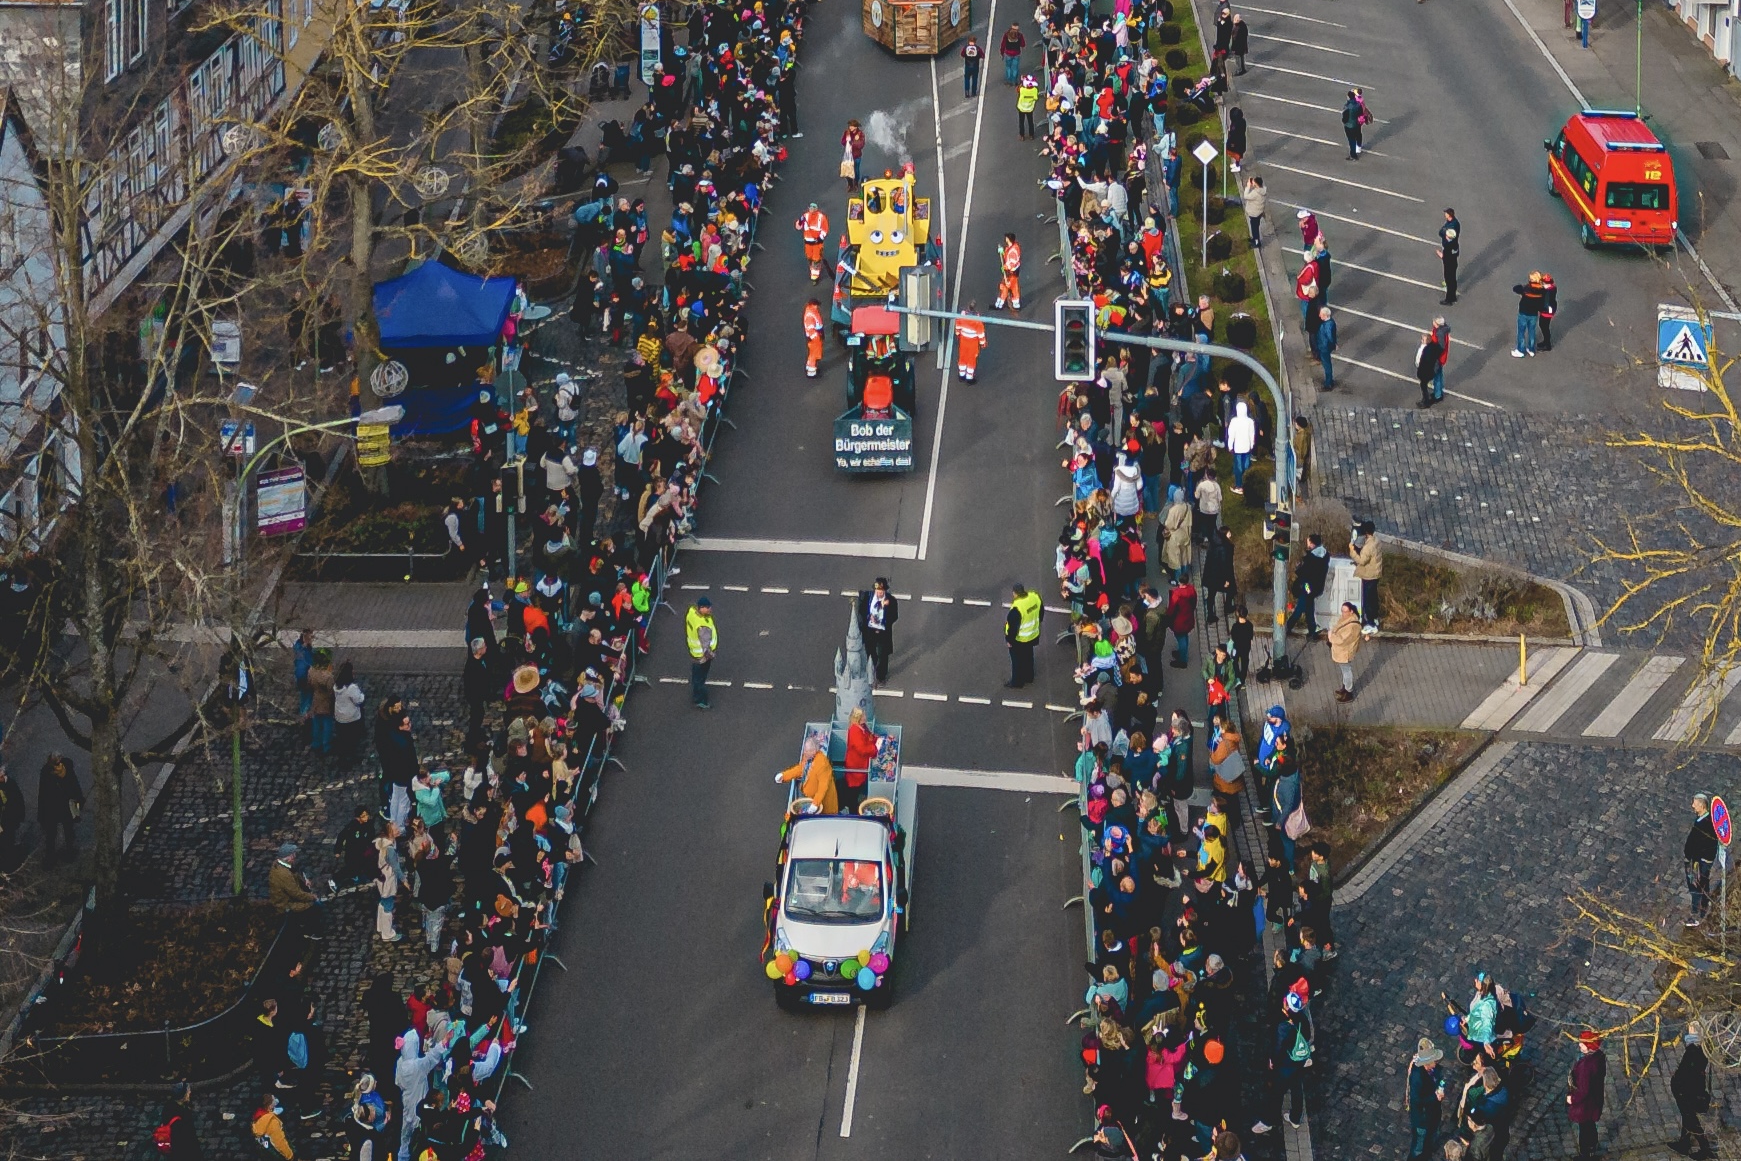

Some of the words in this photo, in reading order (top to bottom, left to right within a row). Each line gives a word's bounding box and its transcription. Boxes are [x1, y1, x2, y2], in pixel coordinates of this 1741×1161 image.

[850, 423, 873, 436] Bob
[875, 423, 894, 436] der
[835, 437, 911, 454] Bürgermeister
